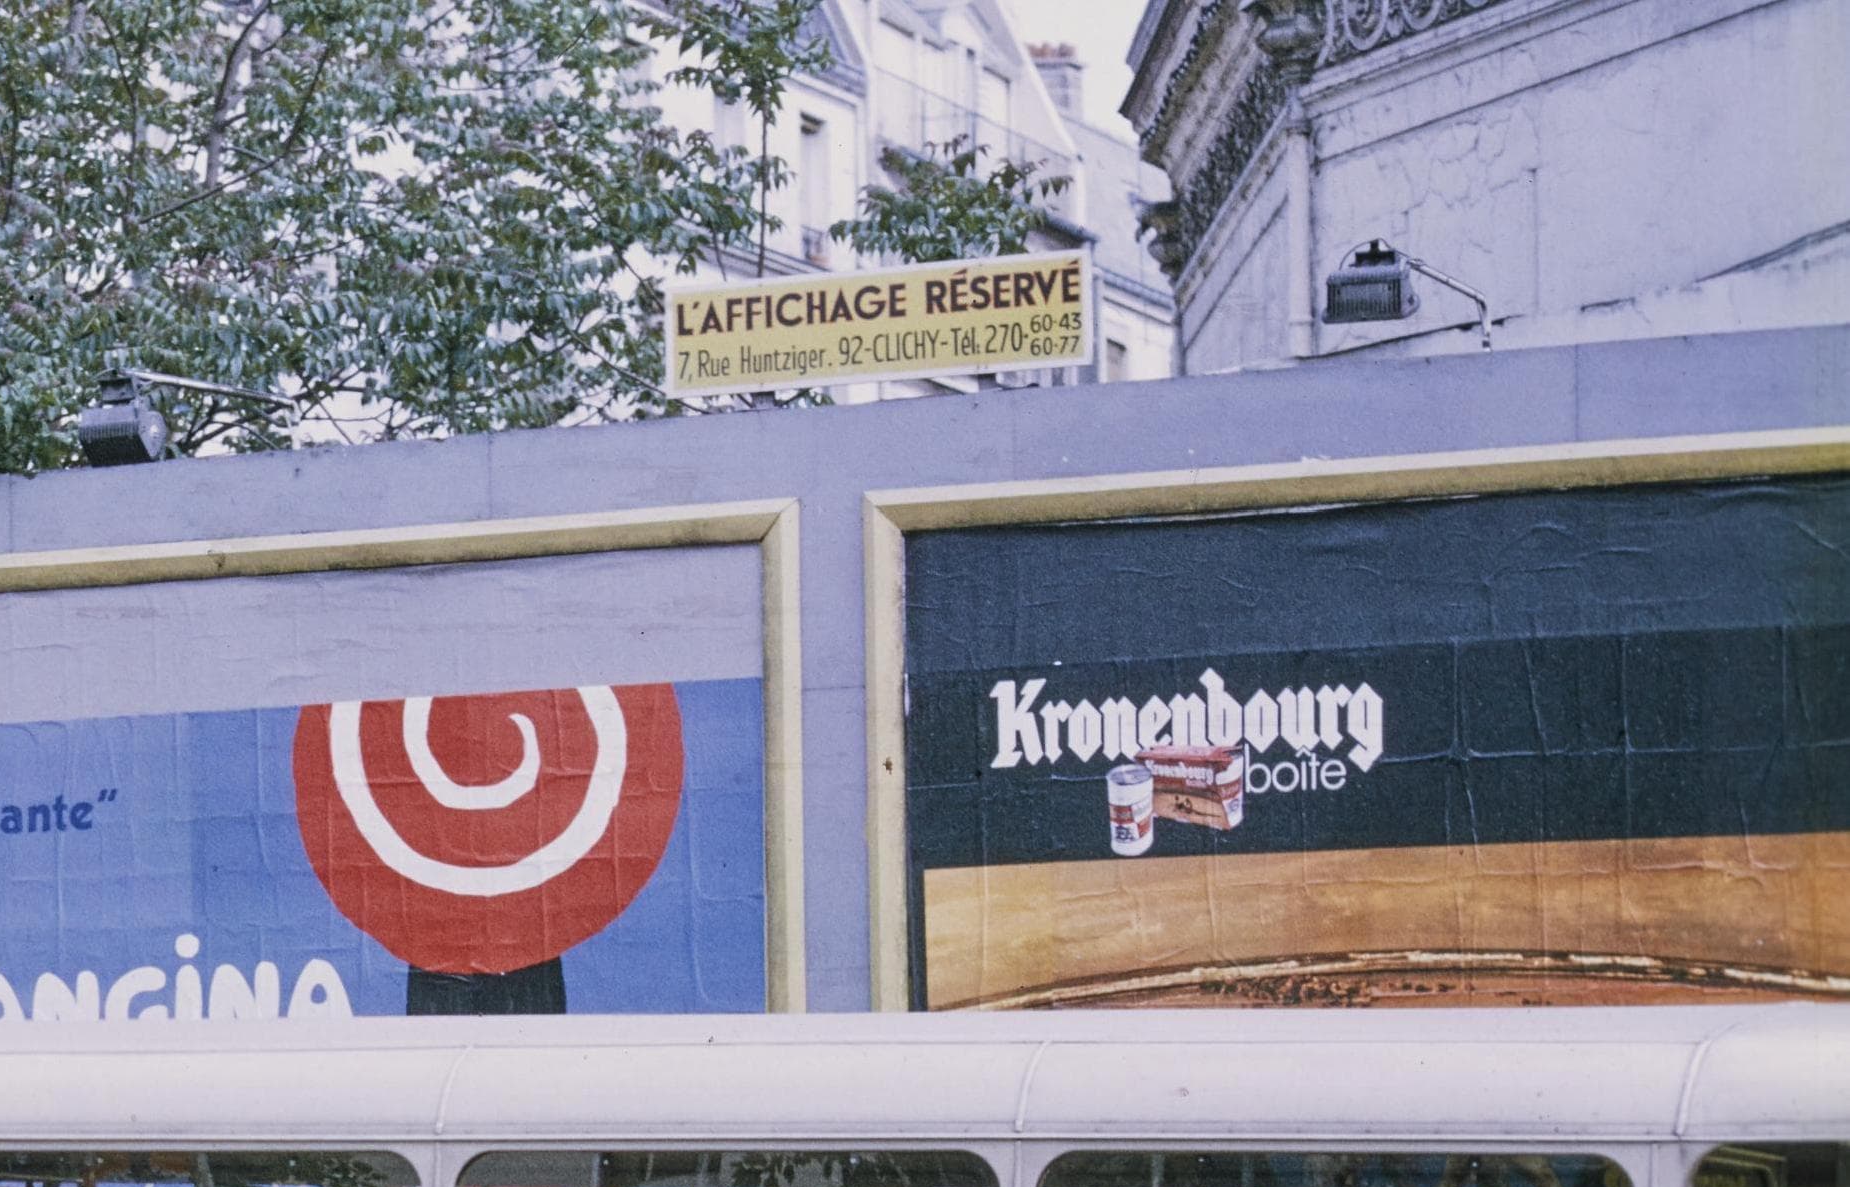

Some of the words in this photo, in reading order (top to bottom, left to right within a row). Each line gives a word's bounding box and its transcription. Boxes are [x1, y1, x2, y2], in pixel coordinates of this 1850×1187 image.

[675, 283, 907, 337] L'AFFICHAGE
[925, 260, 1082, 315] RÉSERVÉ
[698, 352, 731, 378] Rue
[989, 667, 1384, 773] Kronenbourg
[1244, 743, 1346, 794] boîte
